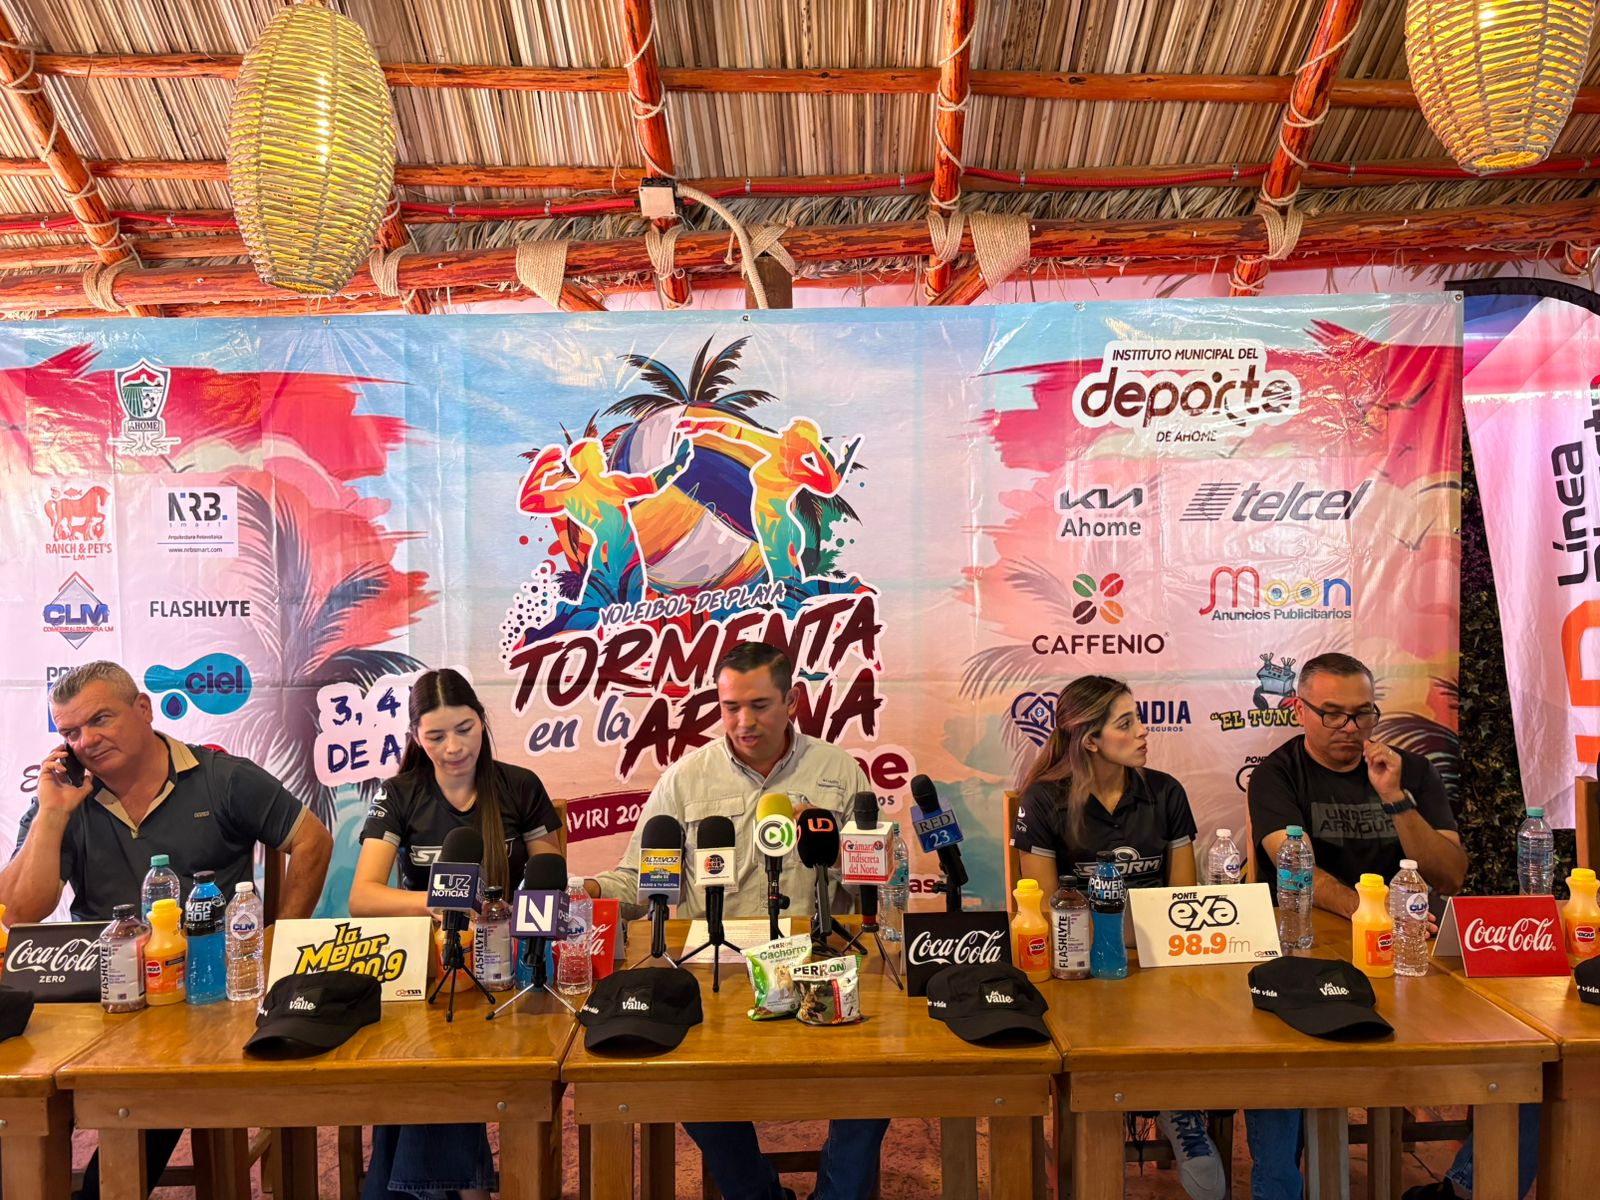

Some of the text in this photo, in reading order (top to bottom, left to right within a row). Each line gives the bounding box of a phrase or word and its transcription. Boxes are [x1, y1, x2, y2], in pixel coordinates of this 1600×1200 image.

[1112, 347, 1259, 362] INSTITUTO MUNICIPAL DEL
[1080, 364, 1293, 428] deporte
[129, 421, 158, 430] AHOME
[1155, 430, 1217, 443] DE AHOME
[1231, 480, 1373, 522] telcel
[1552, 440, 1588, 587] Línea
[1060, 517, 1142, 538] Ahome
[45, 543, 113, 554] RANCH & PET'S
[149, 600, 251, 618] FLASHLYTE
[600, 583, 785, 626] VOLEIBOL DE PLAYA
[1211, 606, 1352, 622] Anuncios Publicitarios
[43, 603, 110, 627] CLM
[1032, 633, 1166, 655] CAFFENIO
[509, 596, 882, 712] TORMENTA
[376, 687, 401, 718] 4
[1135, 701, 1192, 725] NDIA
[529, 695, 630, 752] en la
[617, 667, 883, 780] ARNA
[327, 739, 370, 774] DE
[918, 813, 951, 833] RED
[1325, 808, 1391, 821] UNDER
[1320, 820, 1395, 834] ARMOUR
[929, 829, 951, 848] 23
[848, 853, 880, 864] Indiscreta
[848, 863, 879, 874] del Norte
[433, 873, 472, 891] LUZ
[1091, 879, 1124, 891] POWER
[432, 889, 469, 898] NOTICIAS
[1172, 892, 1198, 901] PONTE
[1168, 895, 1238, 932] exa
[335, 922, 361, 946] la
[1058, 915, 1068, 968] FLASHLYTE
[760, 945, 807, 961] Cachorro
[1168, 932, 1250, 957] 98.9 fm
[295, 933, 390, 976] Mejor
[475, 927, 485, 982] FLASHLYTE
[39, 975, 66, 984] ZERO
[102, 946, 110, 1000] FLASHLYTE
[985, 994, 1014, 1004] Valle
[1262, 989, 1278, 998] vida
[1320, 985, 1349, 996] Valle
[289, 1000, 316, 1011] Valle
[622, 1001, 650, 1011] Valle
